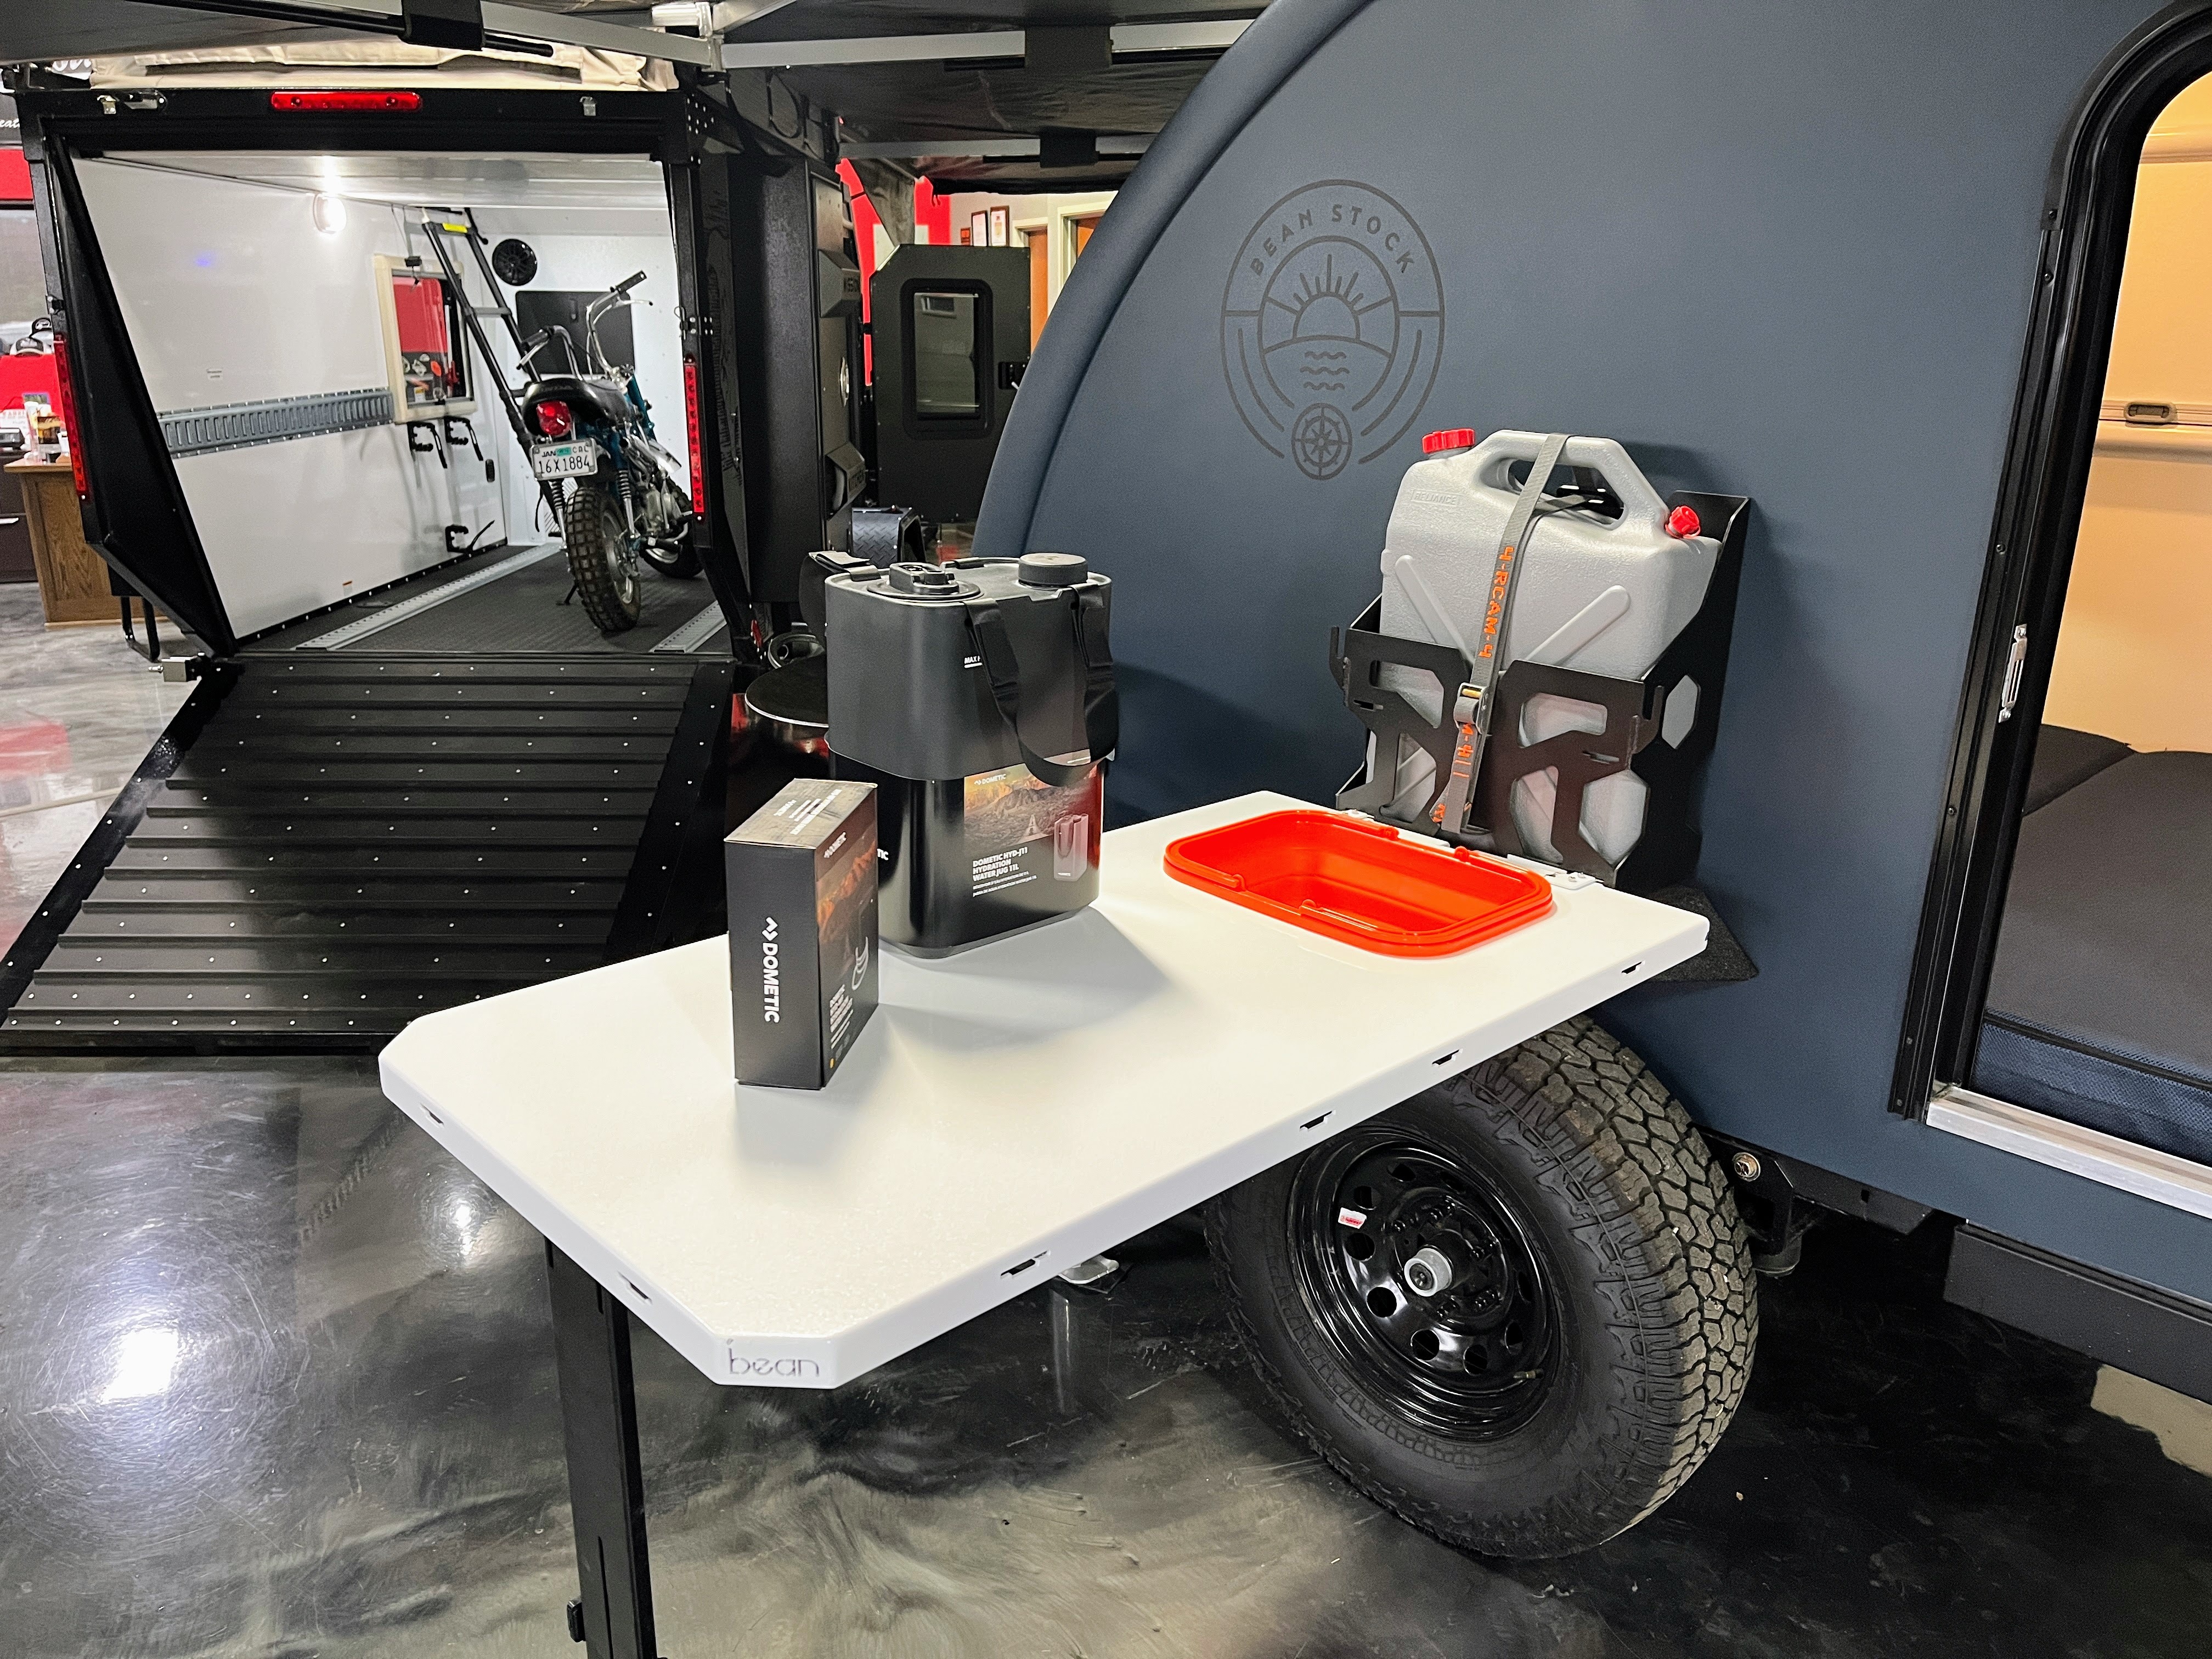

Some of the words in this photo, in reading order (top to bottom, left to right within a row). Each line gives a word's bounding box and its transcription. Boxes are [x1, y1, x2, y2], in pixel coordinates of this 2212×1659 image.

[1249, 208, 1313, 276] BEAN
[1331, 204, 1415, 273] STOCK
[539, 455, 590, 473] 16X1884
[1414, 492, 1457, 505] RELIANCE
[981, 774, 1006, 785] DOMETIC
[972, 853, 1003, 867] DOMETIC
[972, 858, 1012, 874] HYDRATION
[972, 870, 996, 882] WATER
[996, 866, 1009, 877] JUG
[762, 942, 780, 1024] DOMETIC
[726, 1339, 820, 1377] bean
